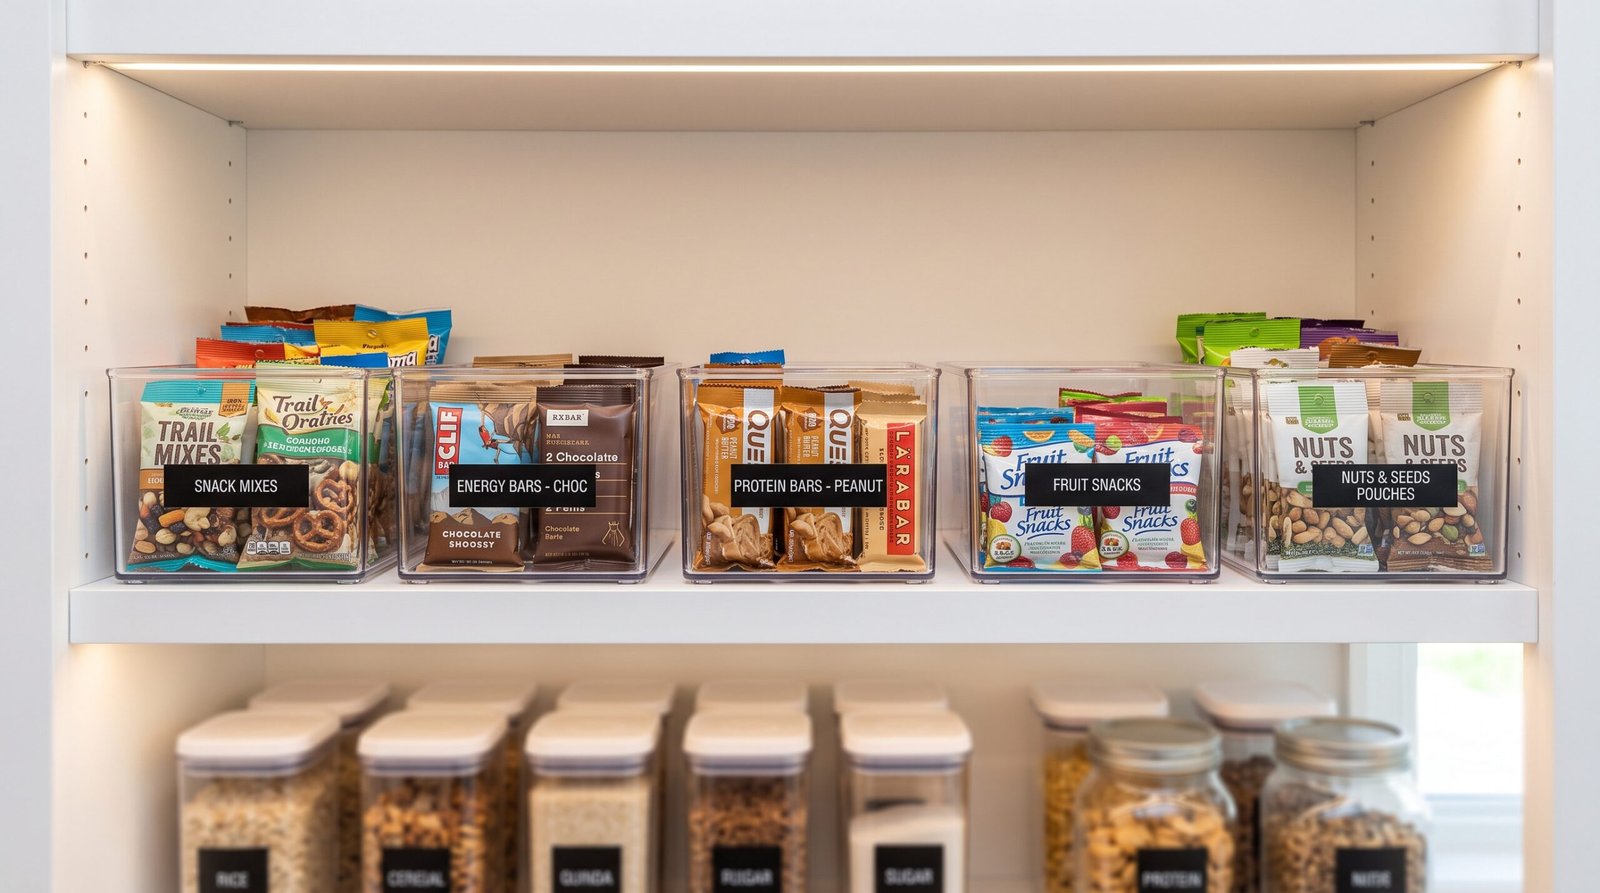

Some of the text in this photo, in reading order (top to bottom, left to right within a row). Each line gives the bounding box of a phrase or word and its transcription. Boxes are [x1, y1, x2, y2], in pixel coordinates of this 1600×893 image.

[273, 394, 319, 413] Trail
[552, 413, 583, 421] RXBAR
[158, 420, 218, 443] TRAIL
[438, 411, 458, 460] CLIF
[747, 410, 770, 465] QUE
[1292, 436, 1354, 459] NUTS
[1403, 434, 1466, 457] NUTS
[154, 443, 222, 466] MIXES
[545, 452, 553, 462] 2
[1016, 449, 1067, 471] Fruit
[1294, 460, 1308, 474] &
[1053, 478, 1141, 492] FRUIT SNACKS
[1341, 470, 1431, 484] NUTS & SEEDS
[194, 479, 278, 493] SNACK MIXES
[457, 479, 505, 493] ENERGY
[509, 479, 542, 493] BARS
[553, 479, 588, 493] CHOC
[734, 479, 786, 493] PROTEIN
[790, 479, 823, 493] BARS
[834, 479, 884, 493] PEANUT
[896, 430, 911, 546] LÄRABAR
[1357, 487, 1415, 501] POUCHES
[1026, 505, 1064, 522] Fruit
[1133, 505, 1171, 520] Fruit
[545, 525, 580, 533] Chocolate
[1016, 517, 1071, 537] Snacks
[1122, 513, 1178, 533] Snacks
[442, 530, 501, 539] CHOCOLATE
[449, 540, 495, 549] SHOOSSY
[215, 871, 249, 888] RICE
